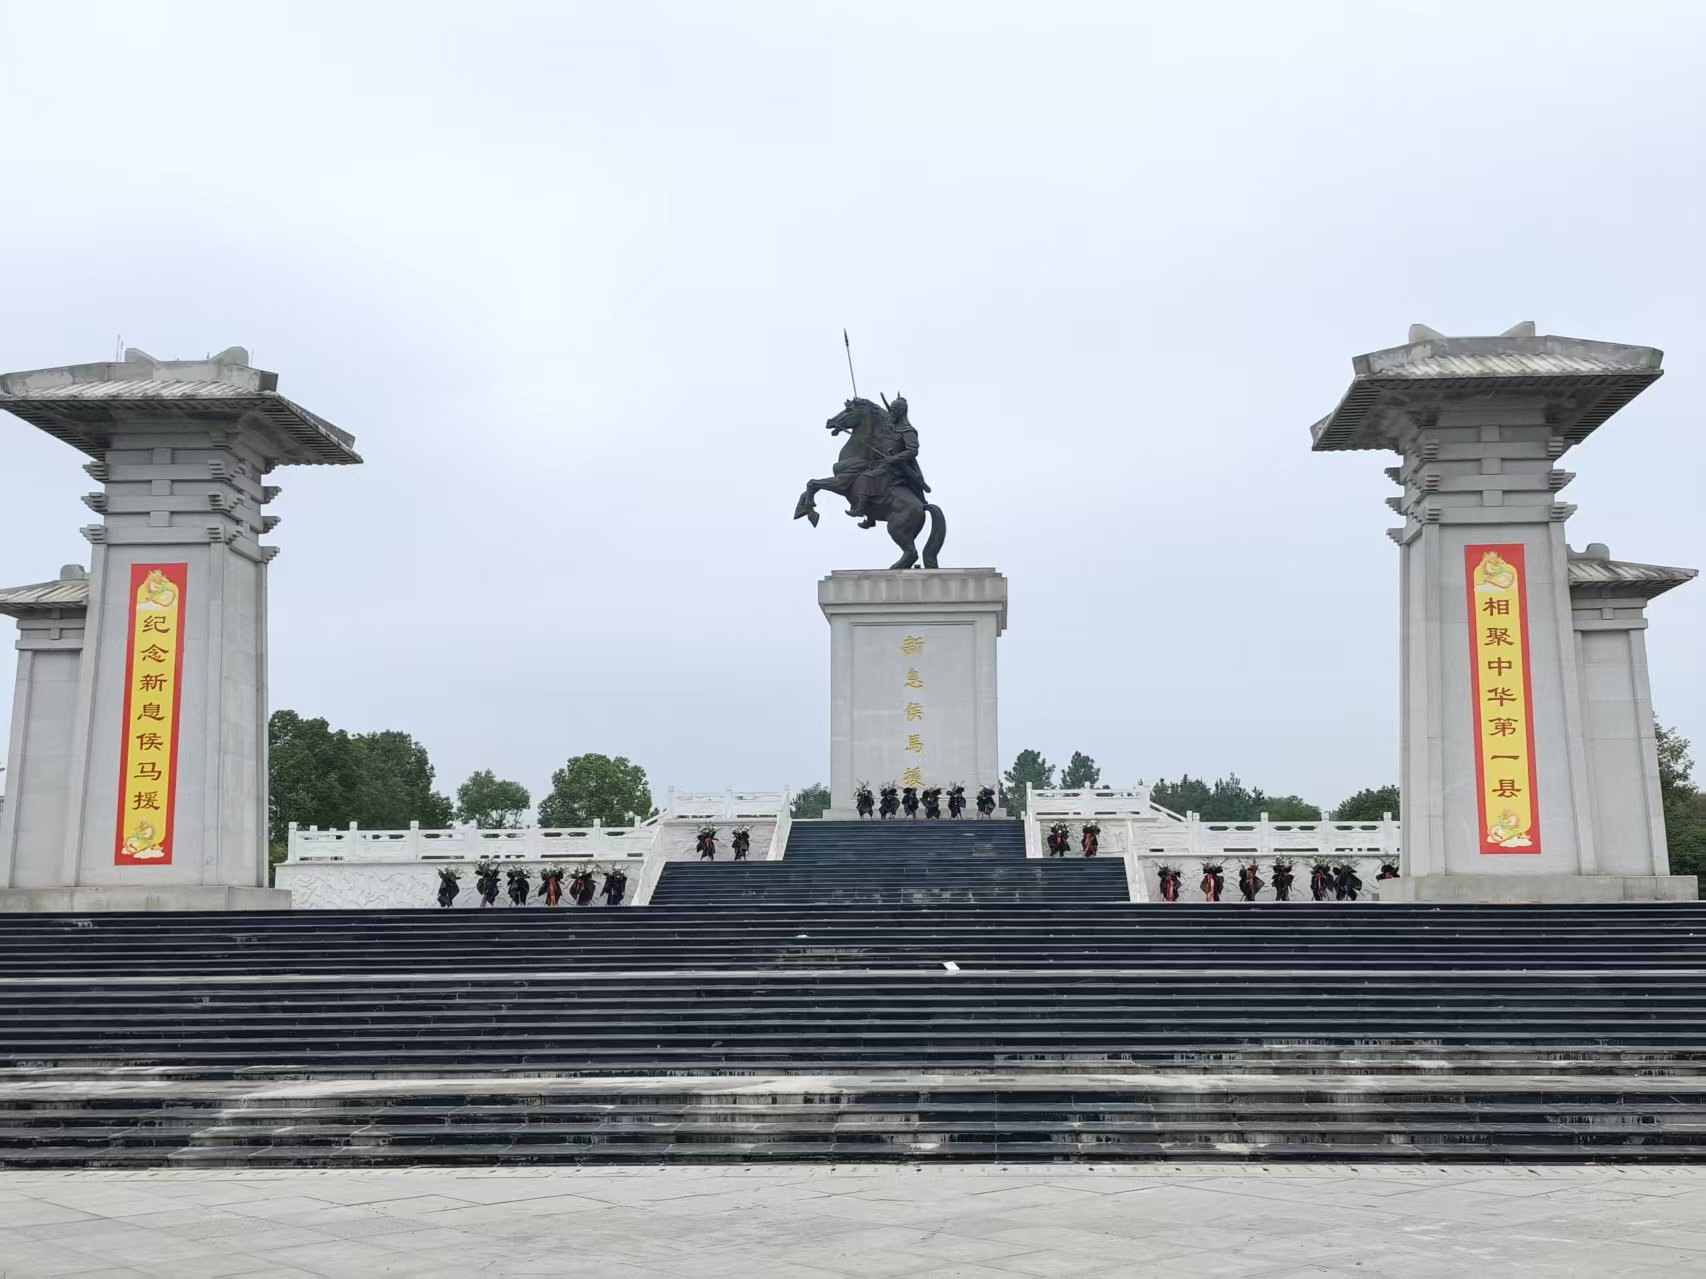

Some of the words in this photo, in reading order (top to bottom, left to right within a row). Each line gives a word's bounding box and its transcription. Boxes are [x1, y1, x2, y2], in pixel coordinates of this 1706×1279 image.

[133, 615, 171, 810] 纪念新息侯马援
[1483, 597, 1522, 798] 相聚中华第一县
